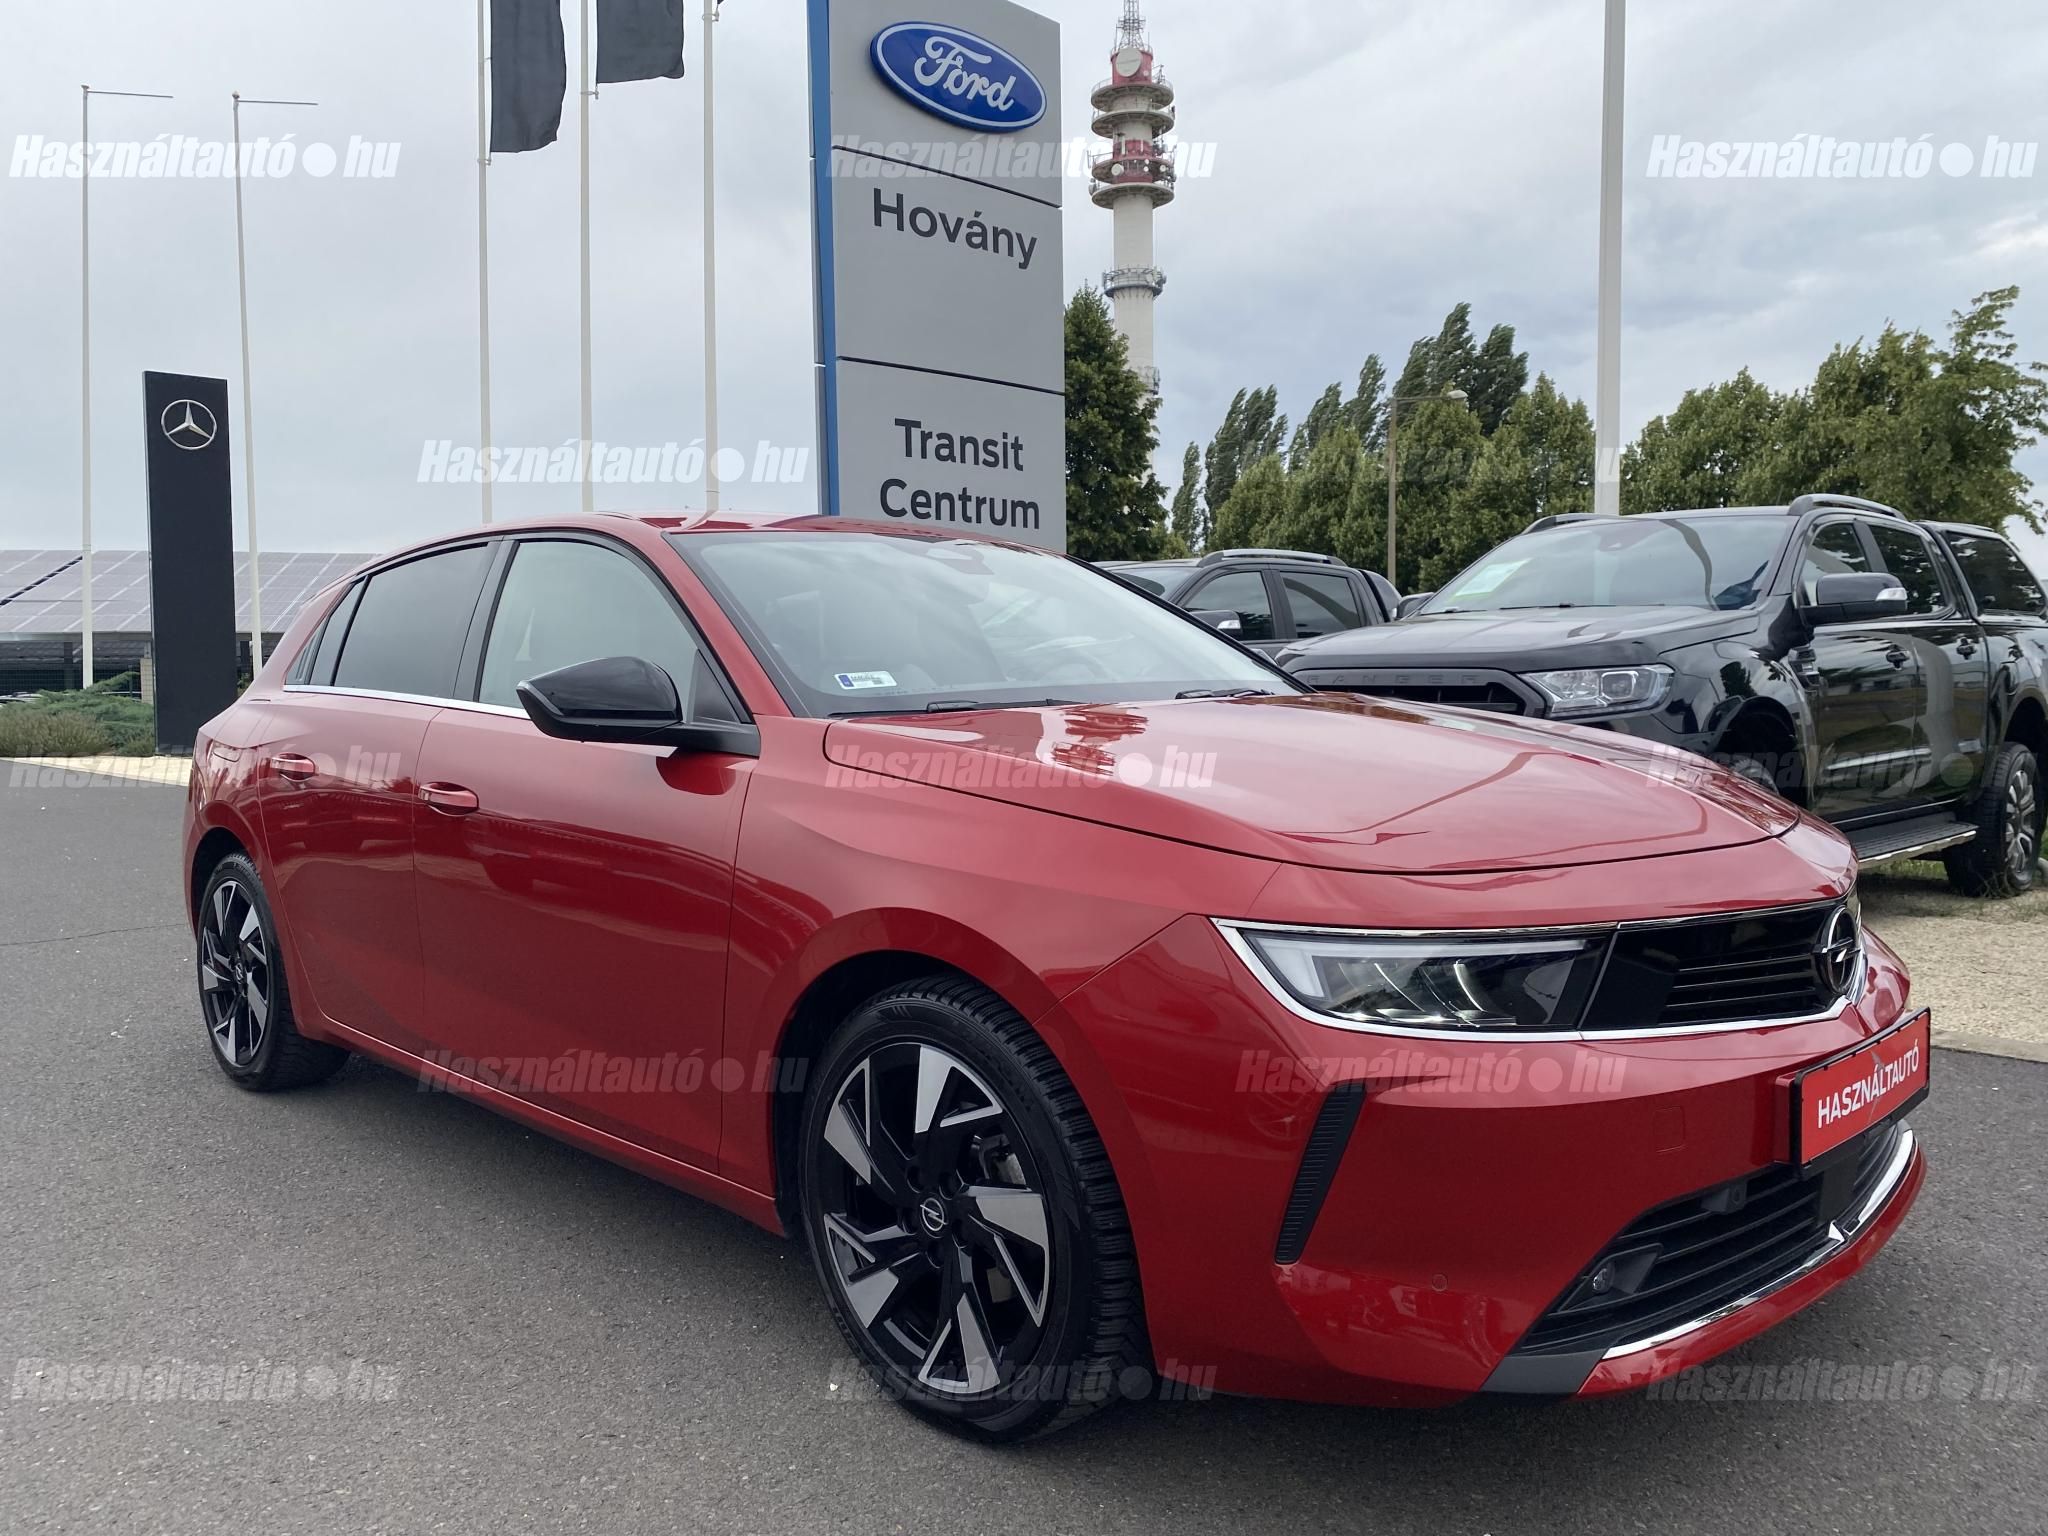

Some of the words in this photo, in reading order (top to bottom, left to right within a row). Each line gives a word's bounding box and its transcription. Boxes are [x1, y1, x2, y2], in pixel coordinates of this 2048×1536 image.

[914, 36, 1016, 111] Ford
[873, 187, 1037, 270] Hovány
[894, 418, 1024, 471] Transit
[880, 478, 1040, 529] Centrum
[1818, 1038, 1919, 1129] HASZNÁLTAUTÓ
